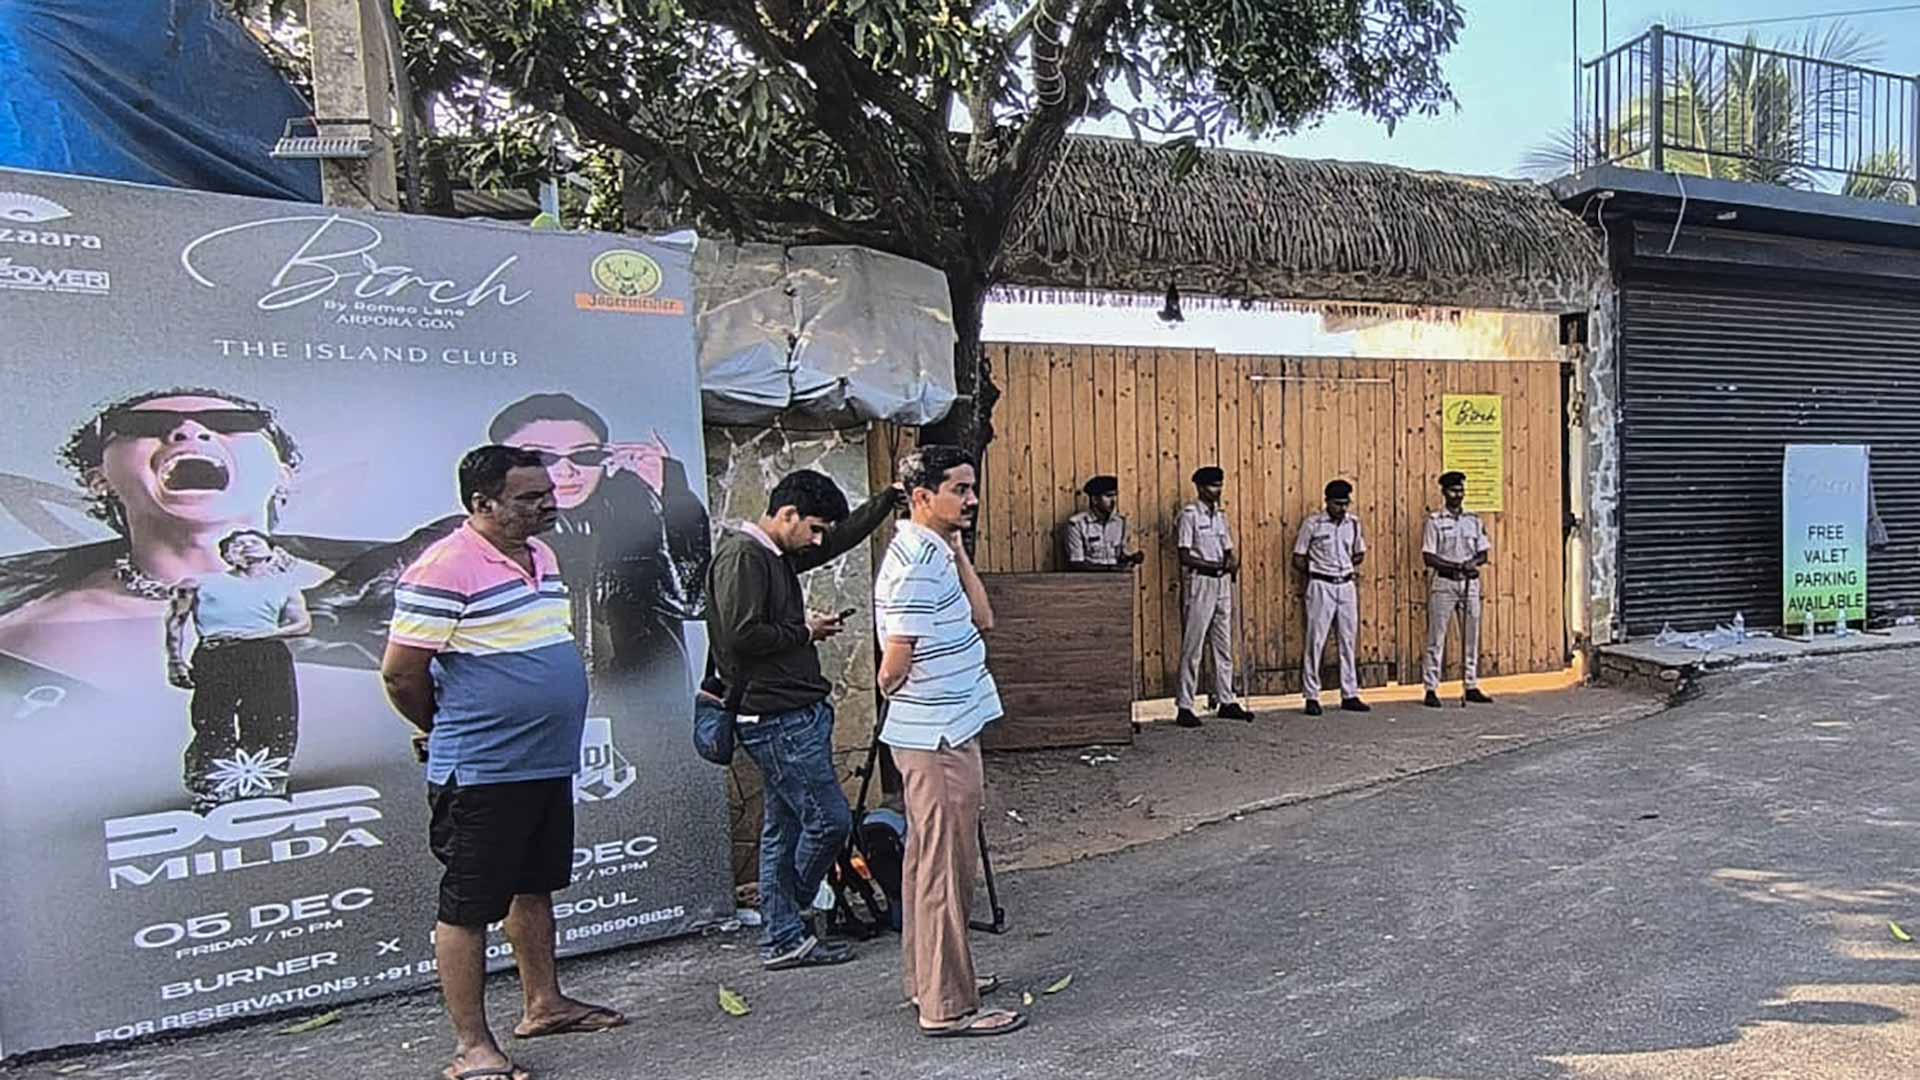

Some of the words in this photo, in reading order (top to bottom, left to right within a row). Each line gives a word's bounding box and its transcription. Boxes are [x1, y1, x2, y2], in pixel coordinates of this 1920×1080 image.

[181, 213, 532, 310] Birch
[324, 300, 347, 312] By
[354, 301, 418, 314] Romeo
[423, 306, 465, 317] Lane
[336, 314, 413, 328] ARPORA
[417, 317, 455, 329] GOA
[213, 339, 288, 359] THE
[305, 342, 427, 363] ISLAND
[442, 349, 518, 366] CLUB
[1808, 525, 1844, 541] FREE
[1804, 548, 1849, 564] VALET
[1795, 570, 1858, 588] PARKING
[1788, 593, 1864, 613] AVAILABLE
[108, 828, 383, 890] MILDA
[573, 836, 658, 868] DEC
[599, 866, 618, 877] 10
[621, 860, 648, 873] PM
[250, 887, 374, 929] DEC
[161, 951, 338, 1000] BURNER
[553, 891, 639, 919] SOUL
[176, 934, 259, 959] FRIDAY
[279, 926, 304, 940] 10
[308, 918, 344, 934] PM
[95, 1020, 154, 1043] FOR
[160, 976, 359, 1029] RESERVATIONS
[375, 963, 412, 980] +91
[565, 905, 685, 941] 8595908825
